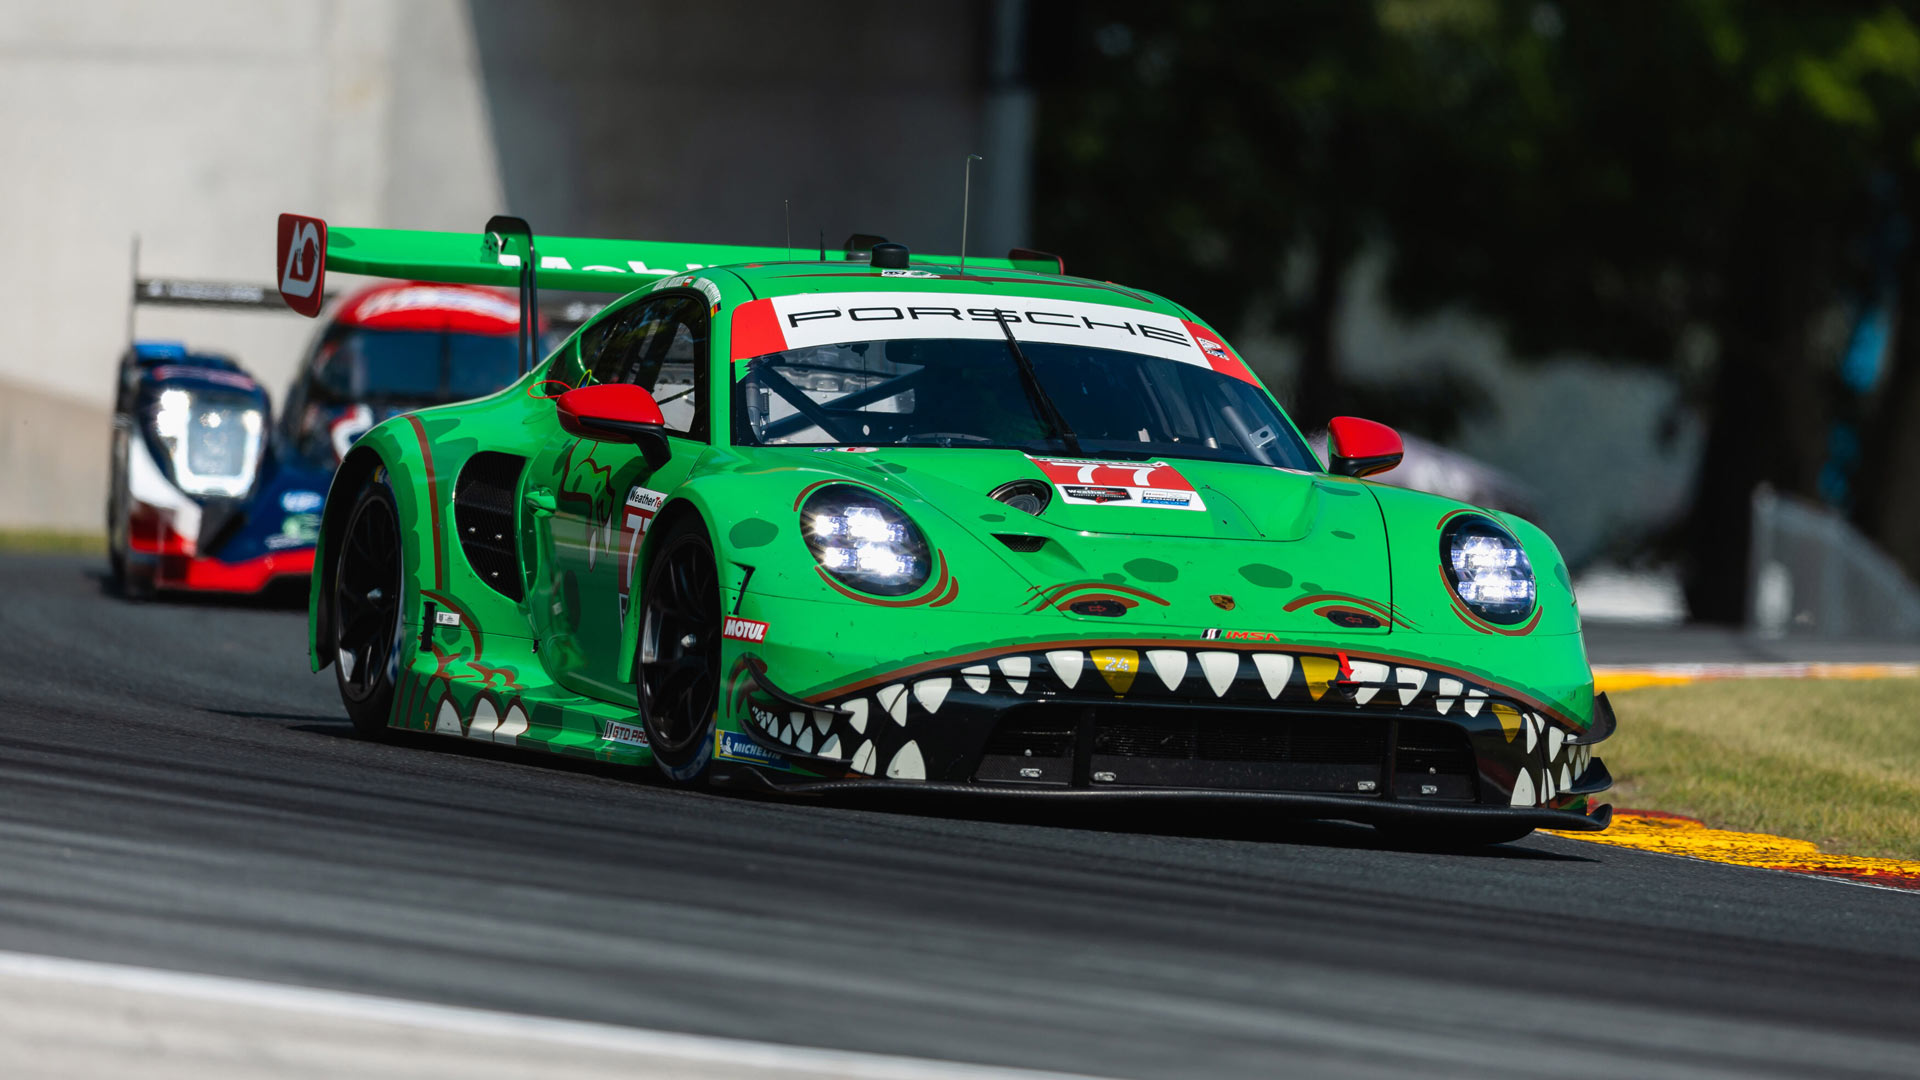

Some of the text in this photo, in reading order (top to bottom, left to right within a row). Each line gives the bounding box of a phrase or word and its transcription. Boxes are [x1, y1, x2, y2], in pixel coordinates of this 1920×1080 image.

[788, 307, 1191, 347] PORSCHE
[1050, 461, 1156, 486] 77
[629, 489, 662, 509] WeatherTe
[724, 619, 766, 641] MOTUL
[1225, 631, 1280, 642] IMSA
[1104, 656, 1130, 672] 24
[612, 725, 631, 740] GTD
